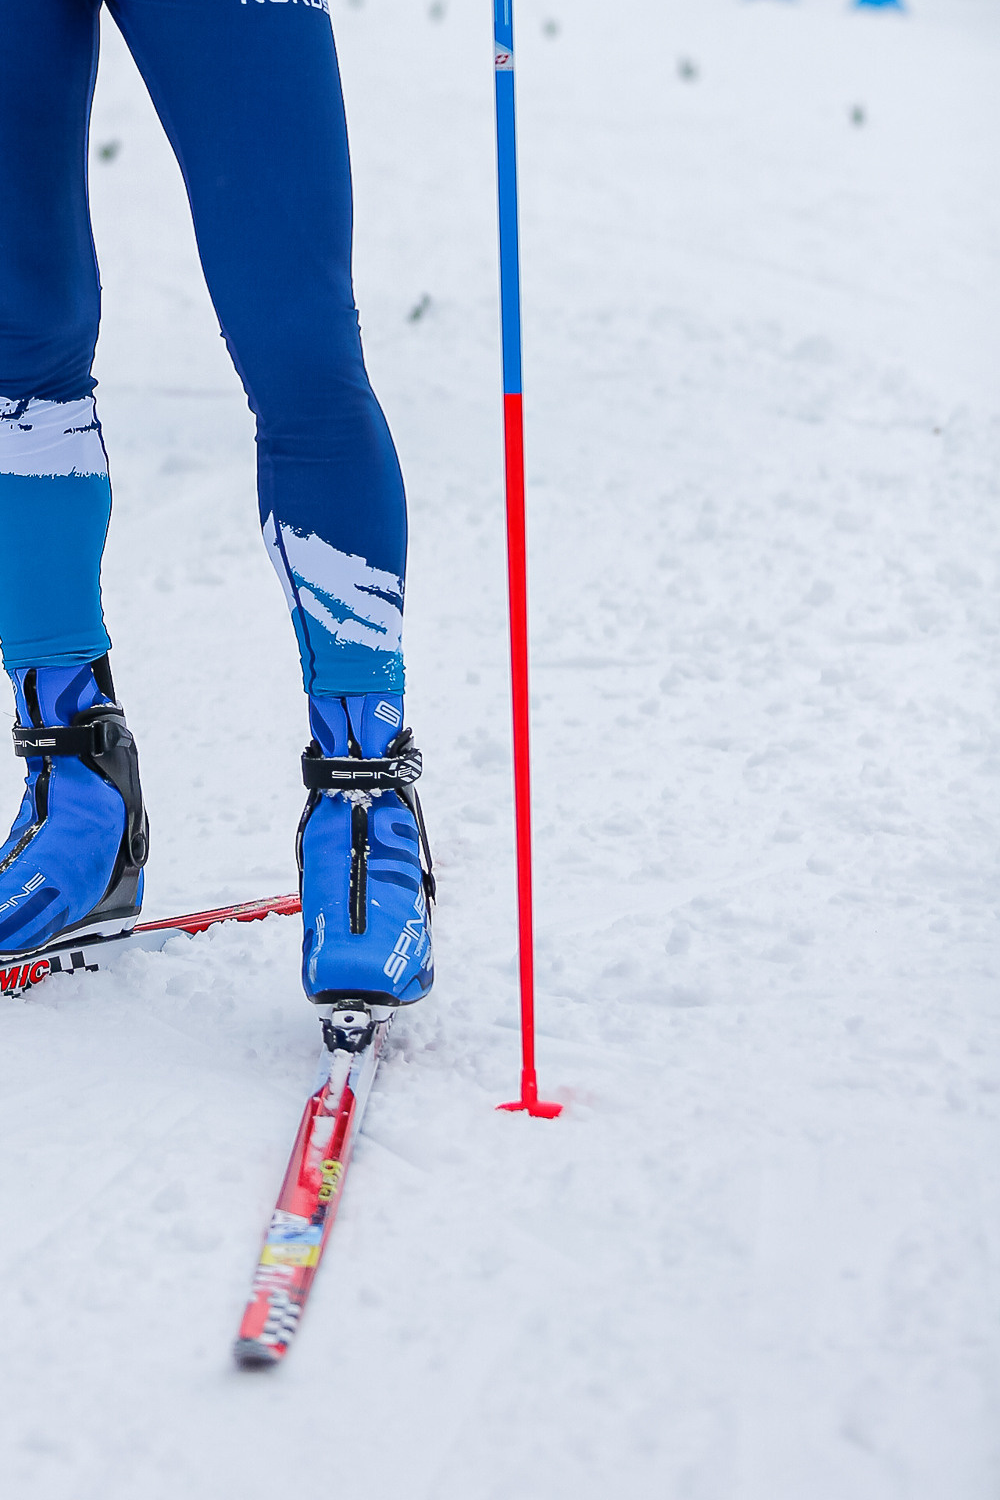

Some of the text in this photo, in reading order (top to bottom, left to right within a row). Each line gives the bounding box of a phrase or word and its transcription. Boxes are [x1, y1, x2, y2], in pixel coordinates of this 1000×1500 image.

[14, 738, 57, 748] PINE
[331, 767, 412, 780] SPINE
[383, 886, 427, 984] SPINE
